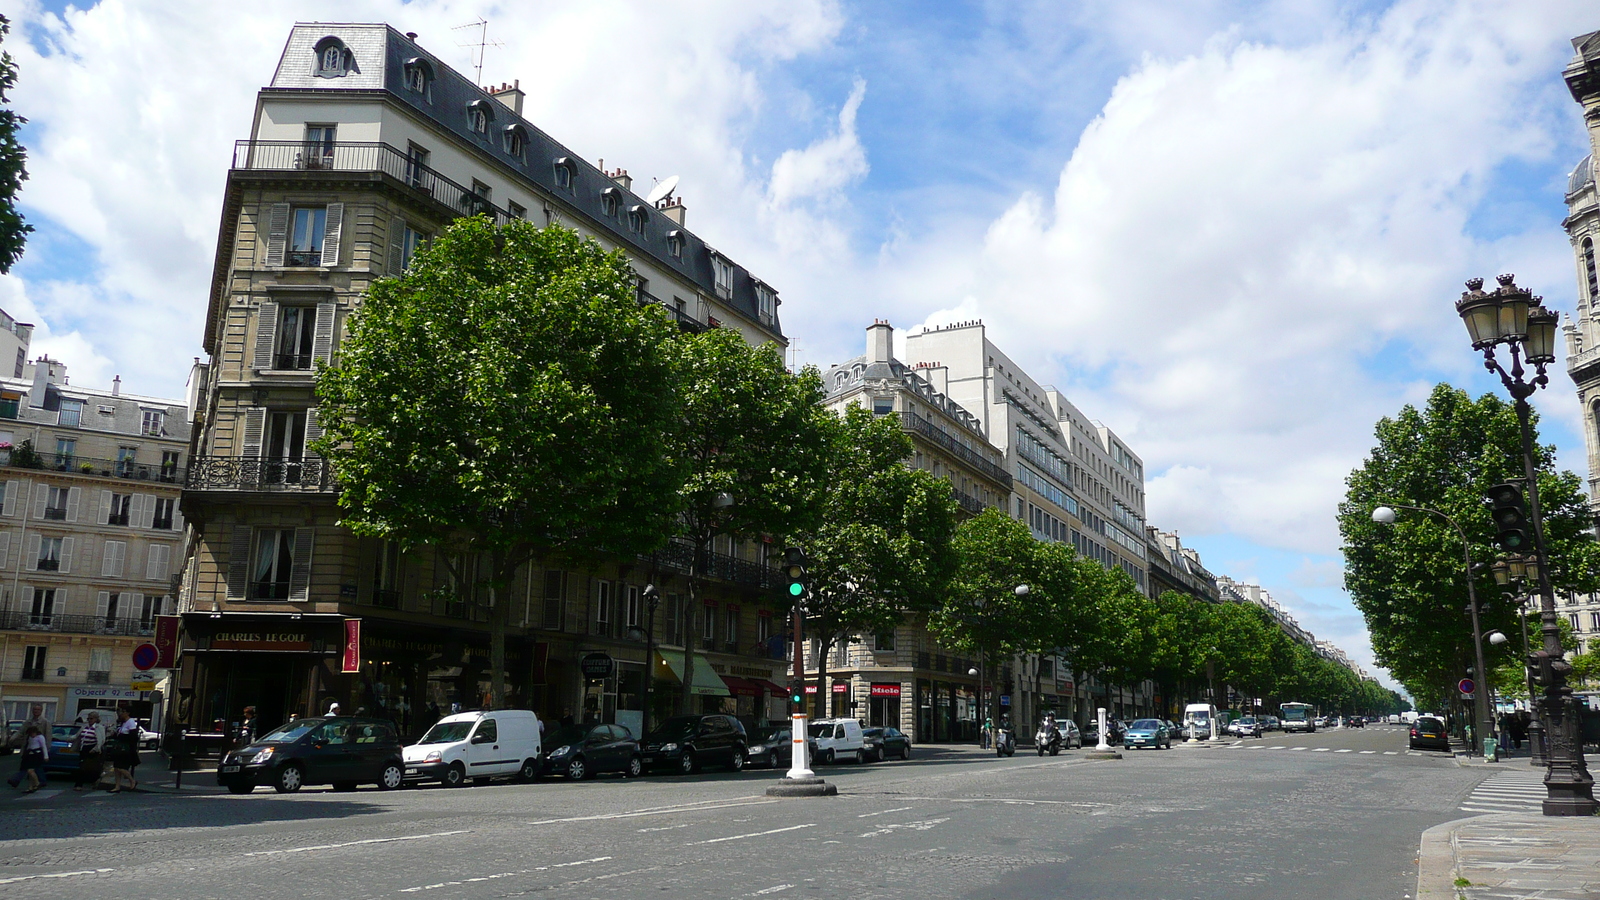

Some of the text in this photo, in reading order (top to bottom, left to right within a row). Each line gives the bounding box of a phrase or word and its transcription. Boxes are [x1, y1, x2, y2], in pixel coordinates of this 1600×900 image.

[215, 632, 307, 643] CHARLES LE GOLF
[75, 688, 107, 697] Objectif
